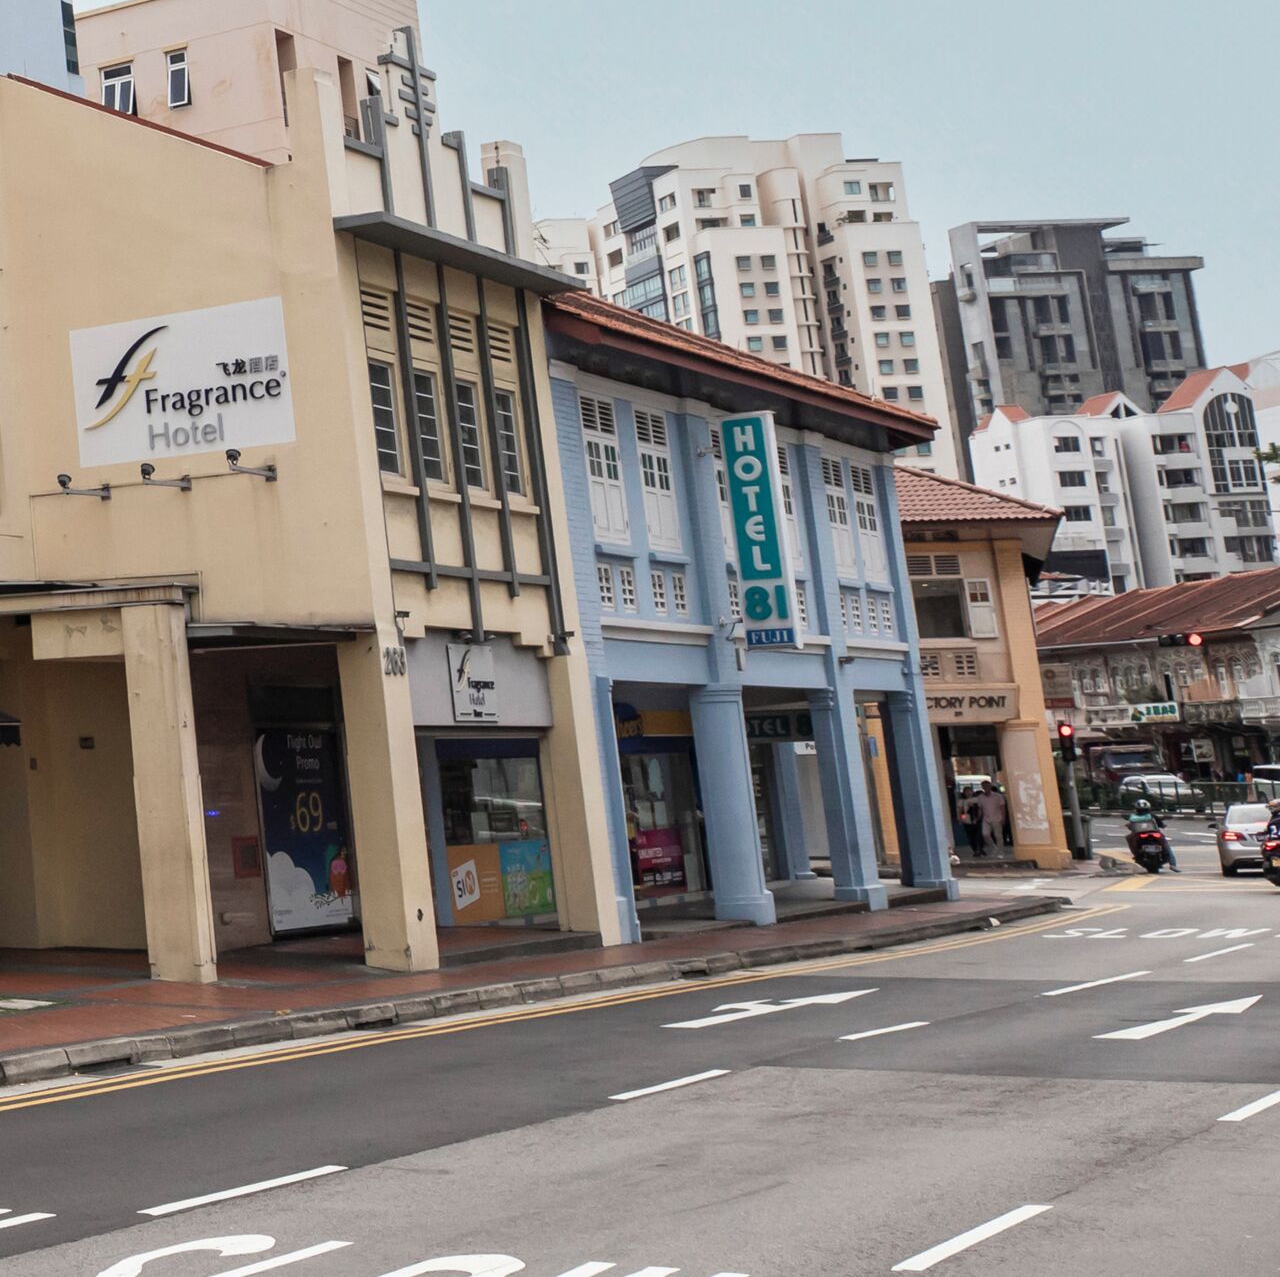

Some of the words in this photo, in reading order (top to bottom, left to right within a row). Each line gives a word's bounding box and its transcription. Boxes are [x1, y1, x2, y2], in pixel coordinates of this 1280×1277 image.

[144, 377, 282, 417] Fragrance
[148, 412, 225, 451] Hotel
[733, 425, 772, 572] HOTEL
[745, 585, 789, 621] 81
[751, 630, 789, 644] FUJI
[383, 646, 407, 676] 263
[926, 696, 966, 710] CTORY
[968, 696, 1007, 709] POINT
[747, 718, 786, 736] TEL
[296, 756, 320, 770] Promo
[1042, 928, 1272, 939] SLOW
